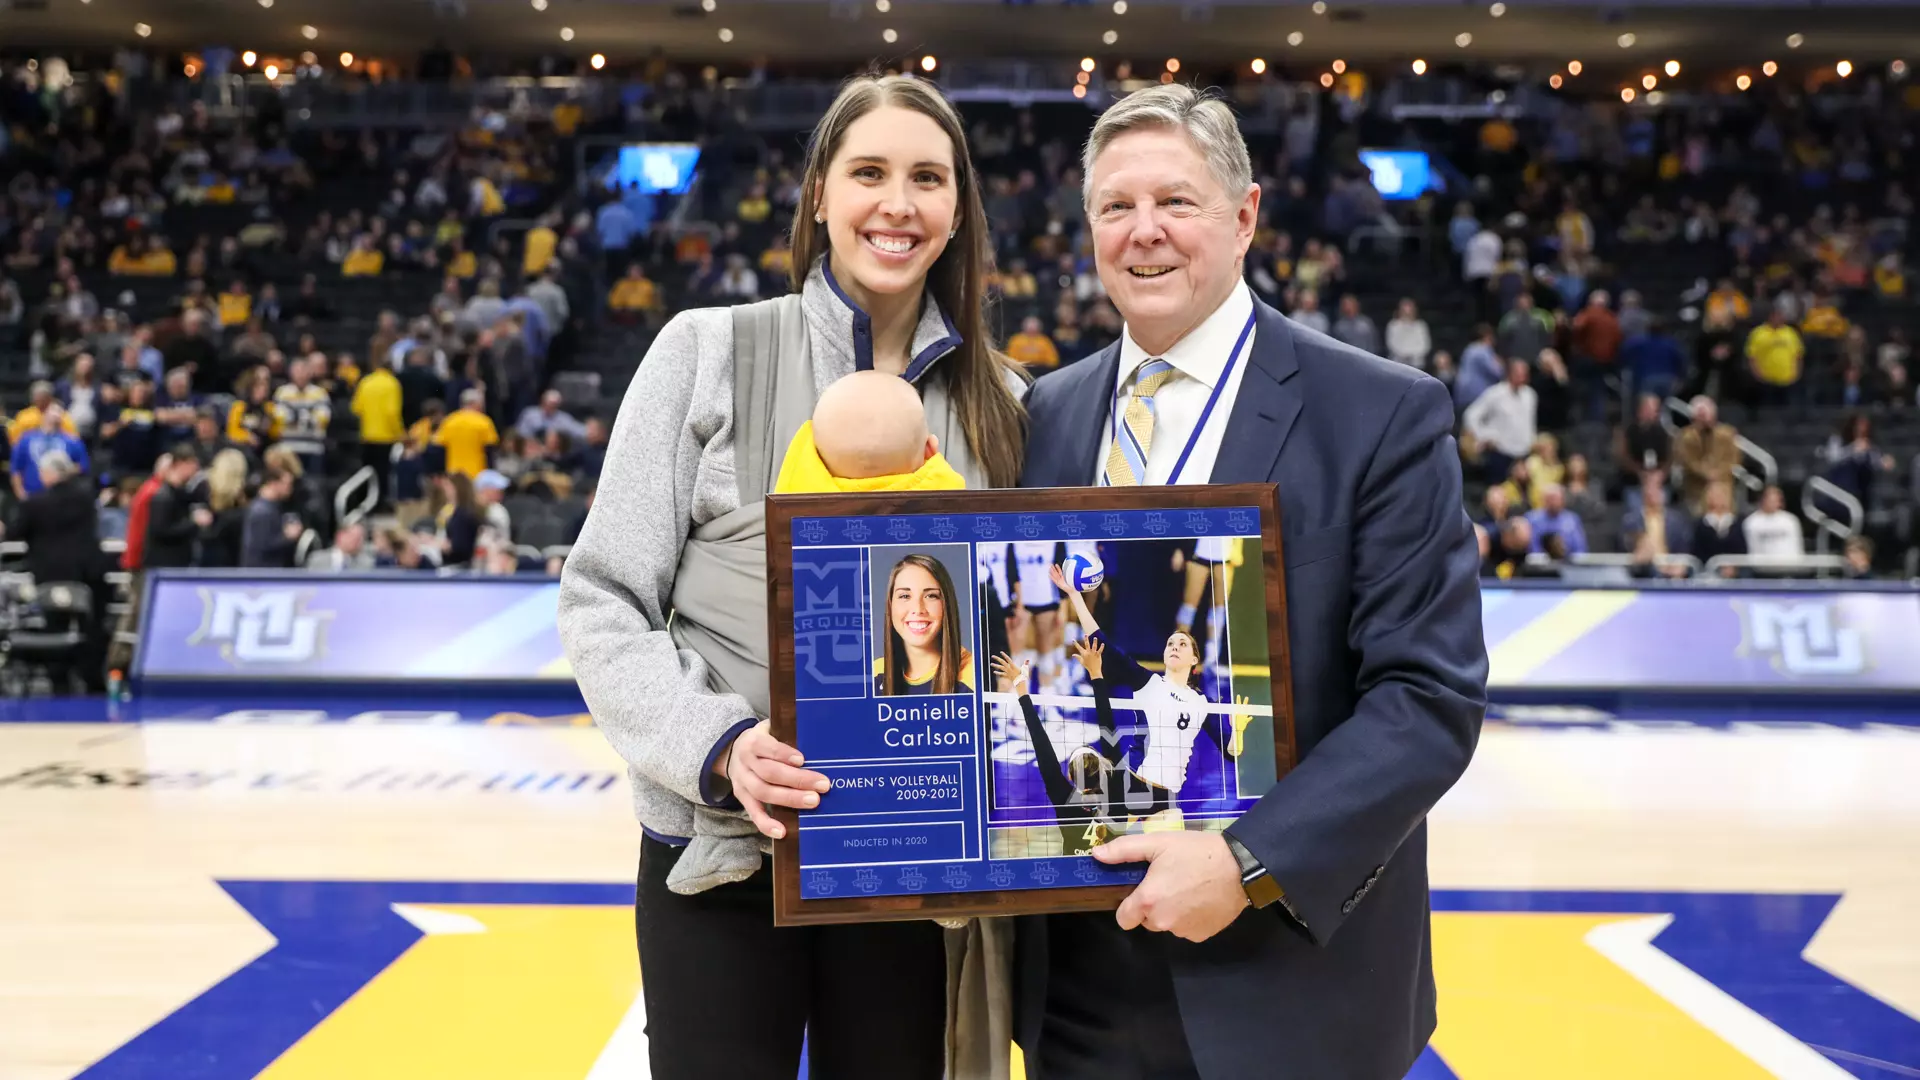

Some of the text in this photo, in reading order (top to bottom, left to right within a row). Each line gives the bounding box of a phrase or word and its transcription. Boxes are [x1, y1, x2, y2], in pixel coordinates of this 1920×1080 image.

[878, 699, 969, 722] Danielle
[884, 725, 970, 747] Carlson
[890, 774, 958, 787] VOLLEYBALL
[896, 788, 958, 801] 2009-2012
[843, 836, 928, 847] INDUCTED IN 2020
